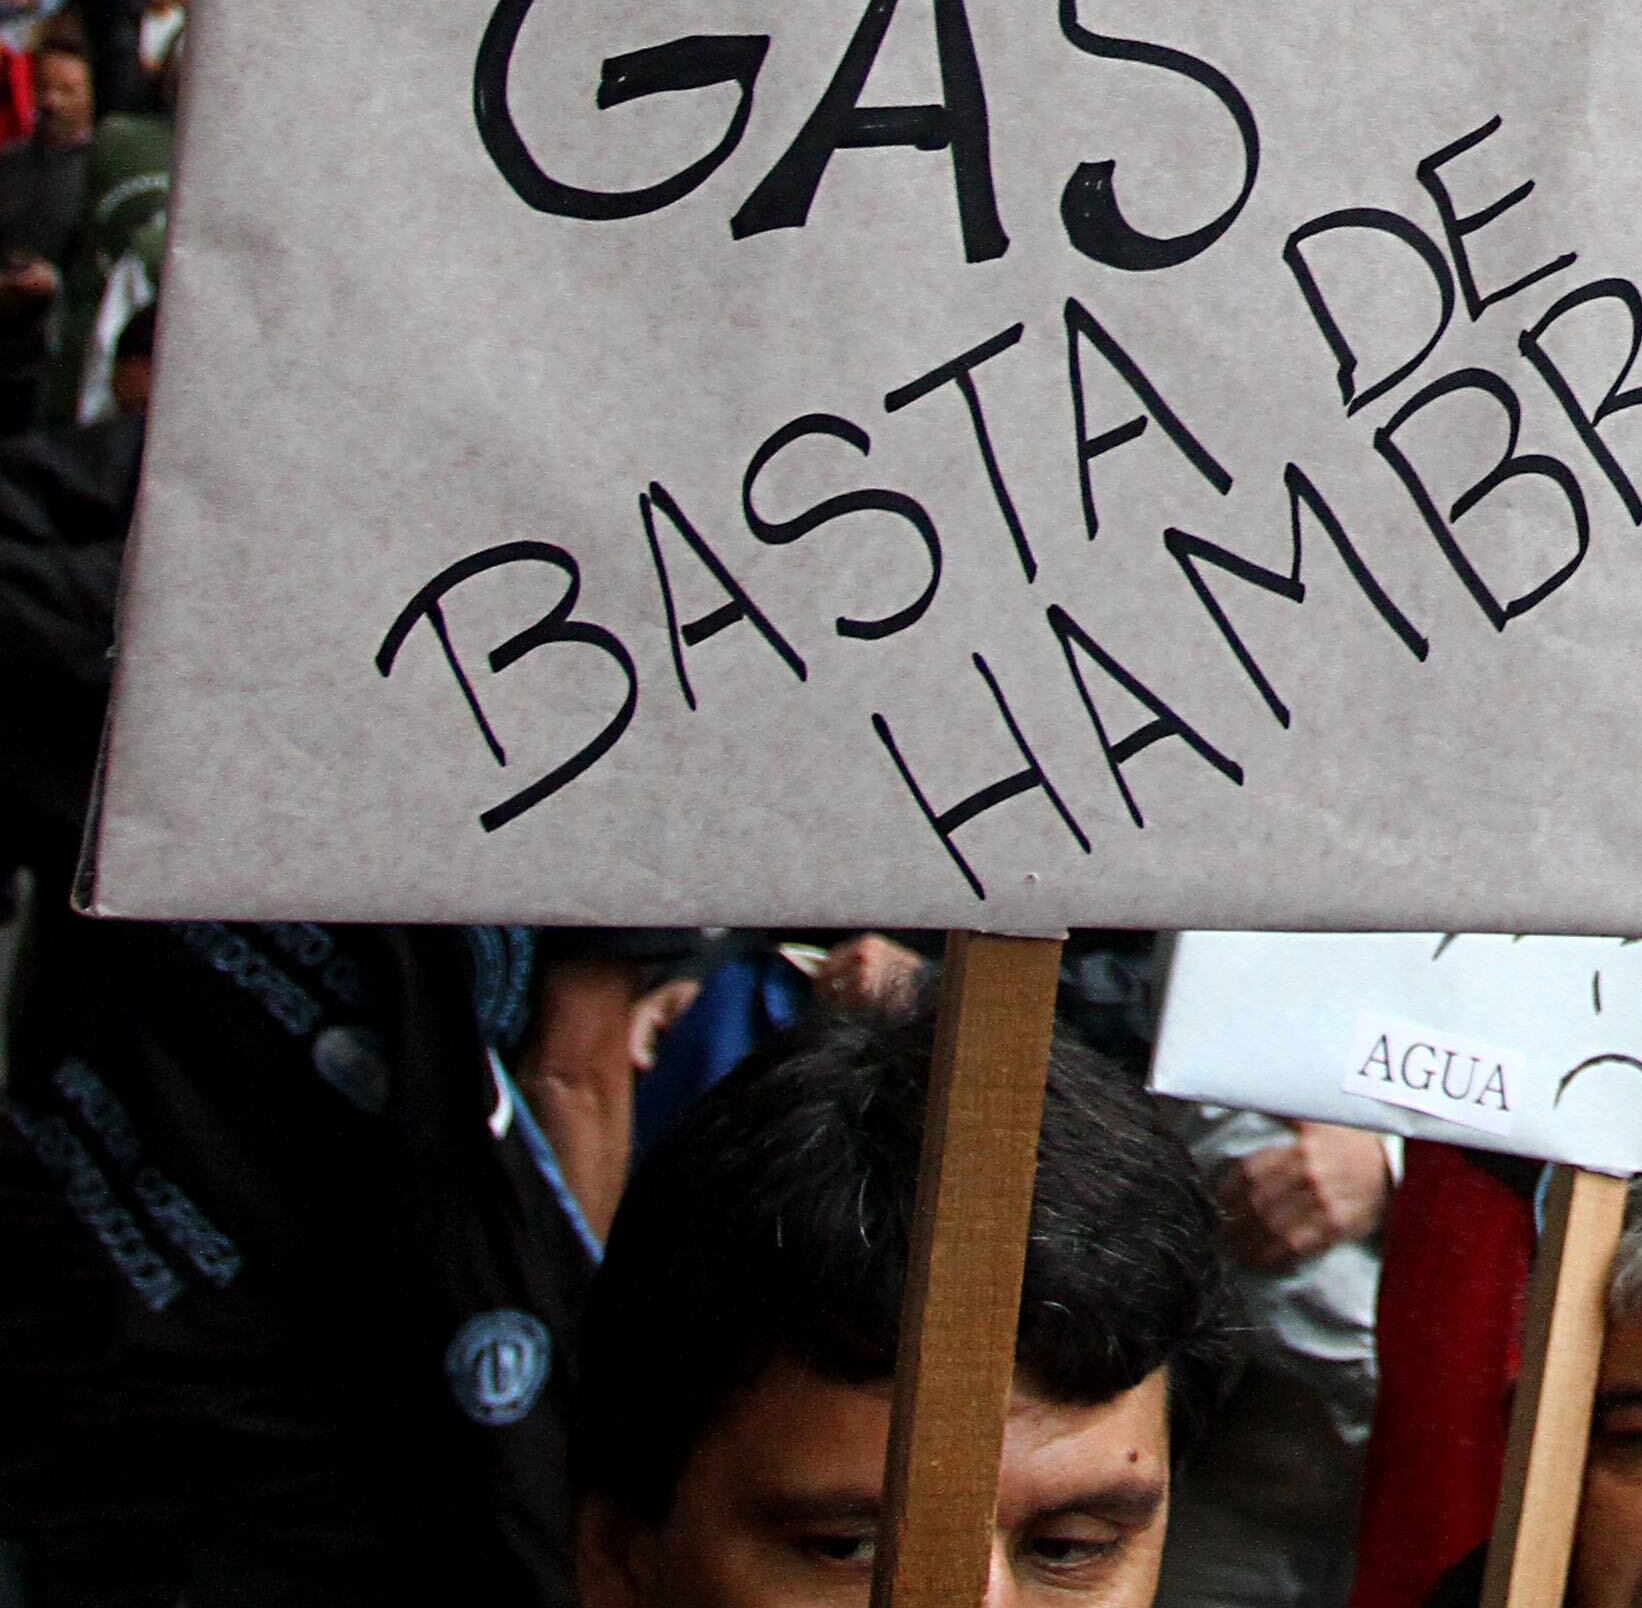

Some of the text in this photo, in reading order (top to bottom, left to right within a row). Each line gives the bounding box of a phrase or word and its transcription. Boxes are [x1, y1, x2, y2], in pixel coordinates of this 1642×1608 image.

[1282, 115, 1579, 419] DE
[373, 297, 1234, 836] BASTA
[1357, 1033, 1514, 1113] AGUA
